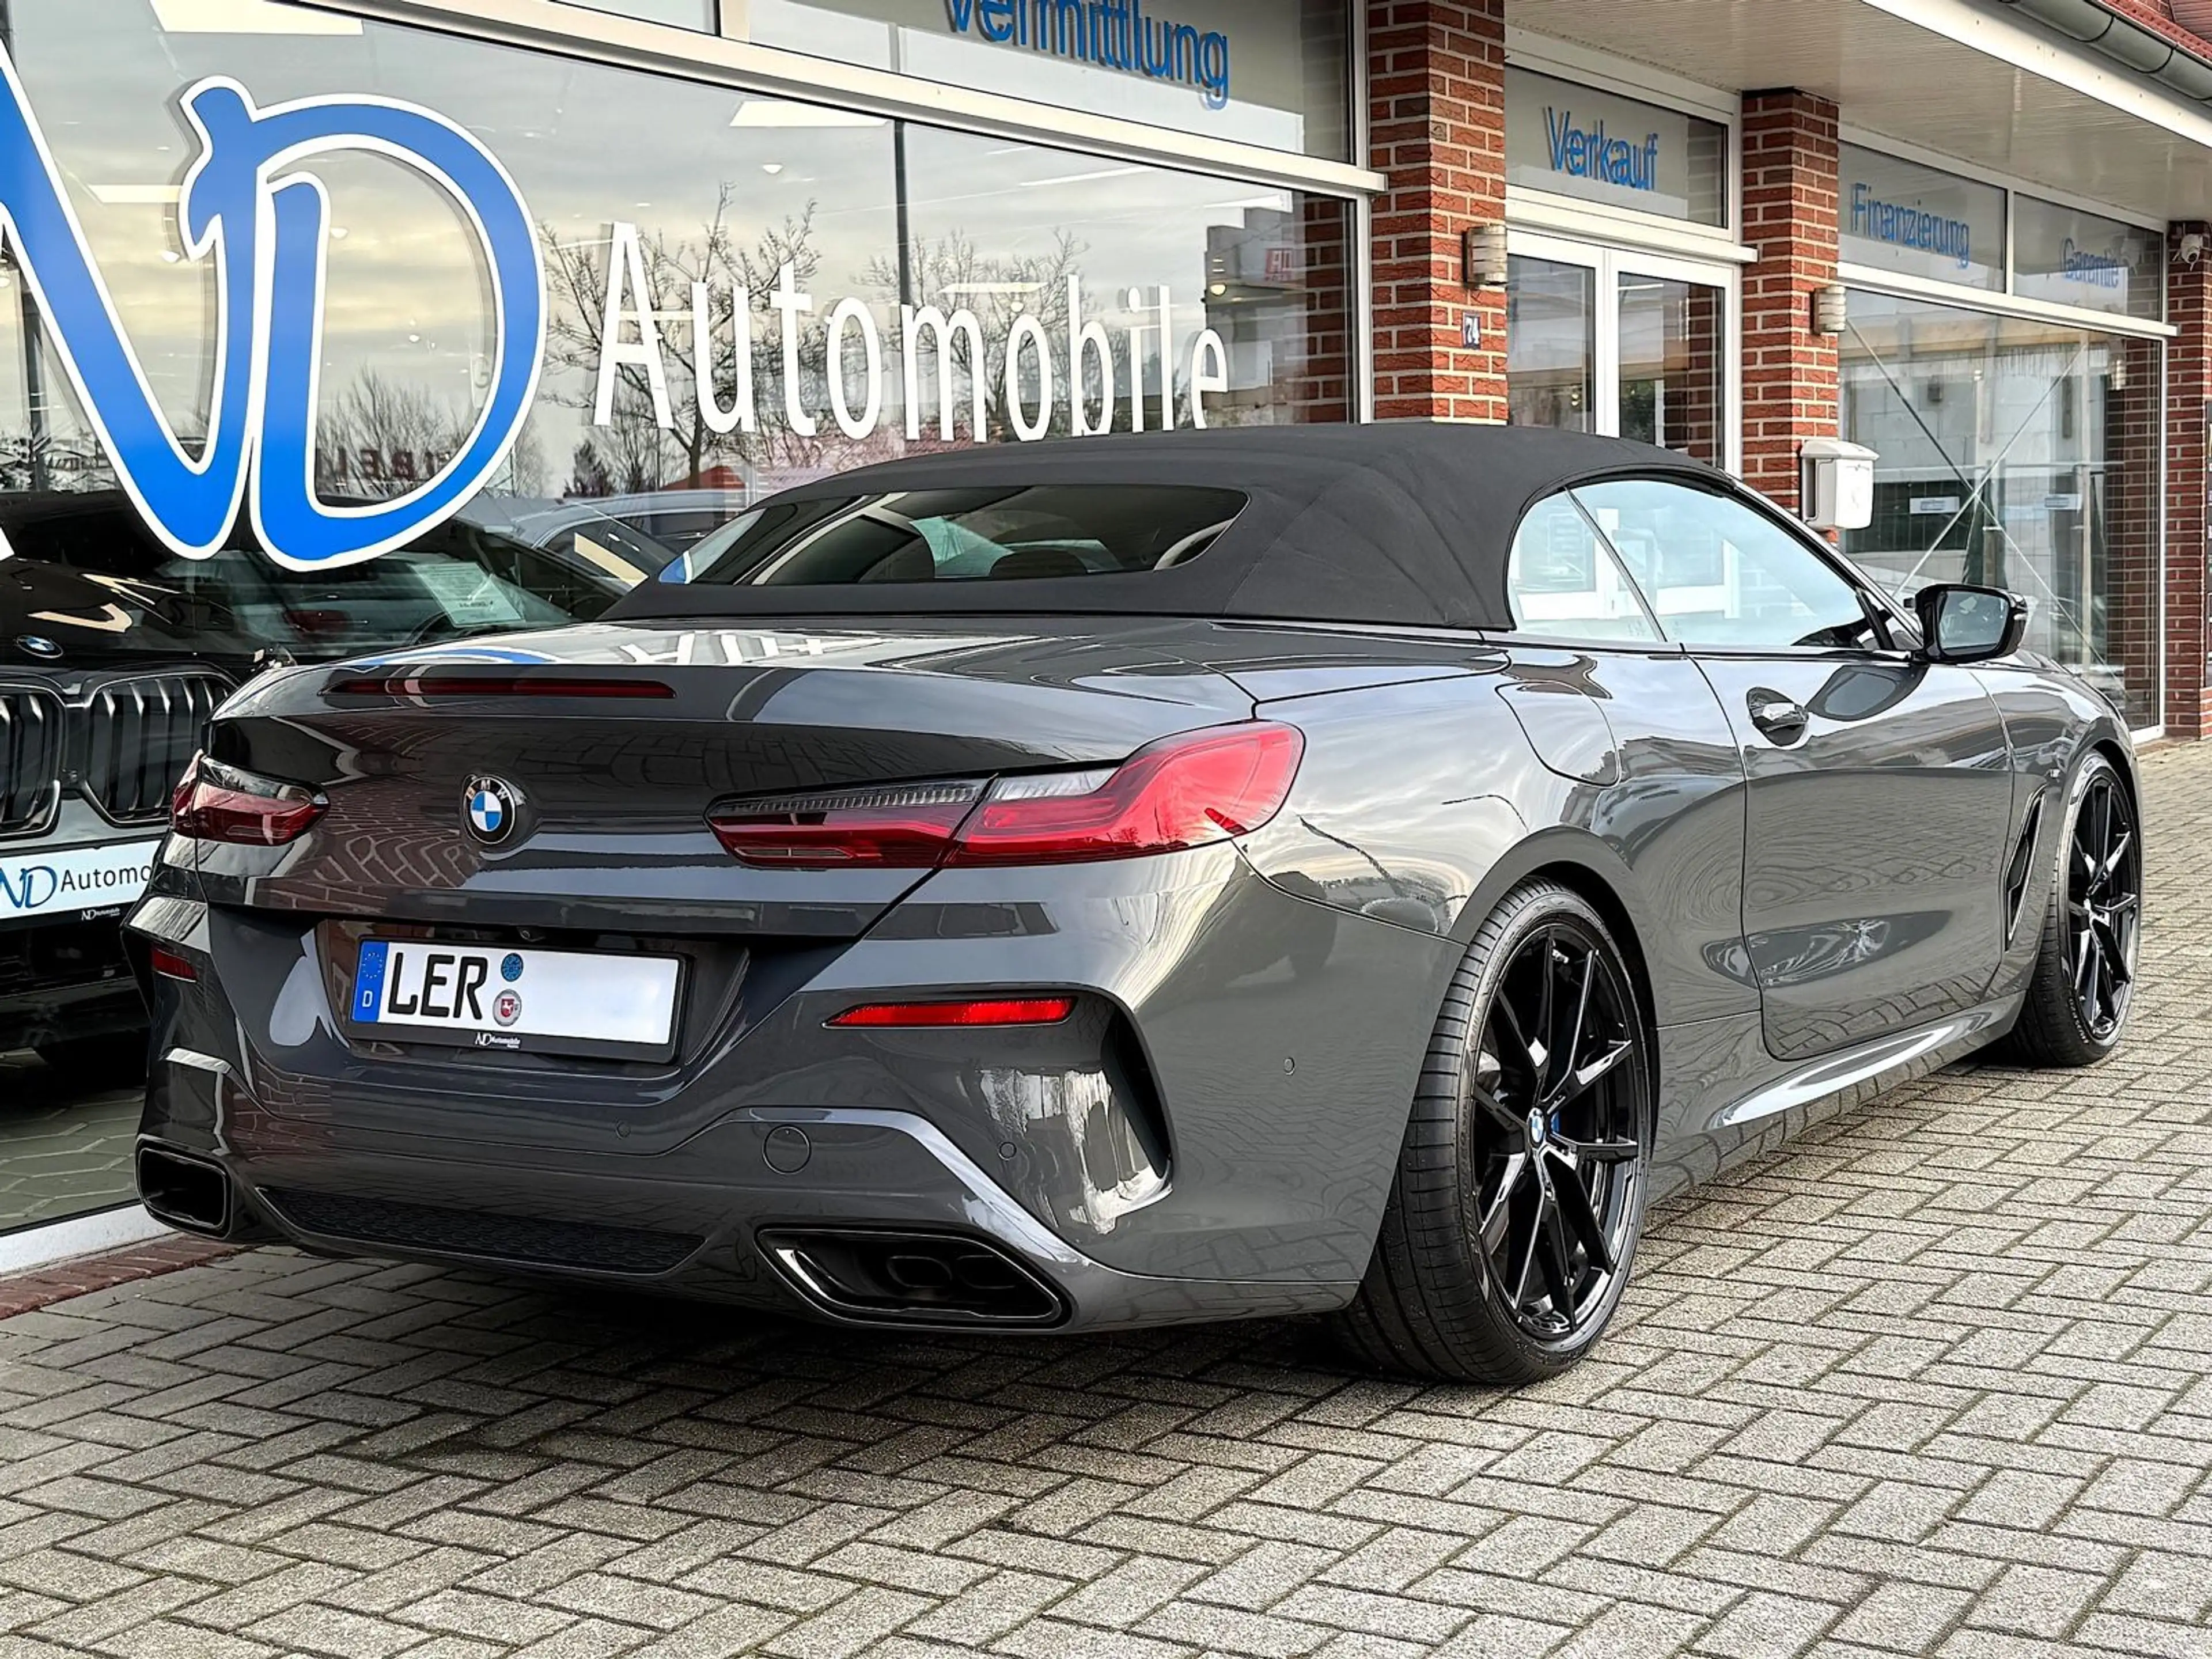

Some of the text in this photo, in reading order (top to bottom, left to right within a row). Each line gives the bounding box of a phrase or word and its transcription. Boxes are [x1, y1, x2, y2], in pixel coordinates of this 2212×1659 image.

[1547, 106, 1658, 190] Verkauf
[1853, 182, 1969, 268] Finanzierung
[593, 222, 1229, 442] Automobile
[1464, 316, 1480, 344] 74
[465, 779, 510, 801] BMW
[362, 990, 373, 1007] D
[387, 952, 488, 1020] LER
